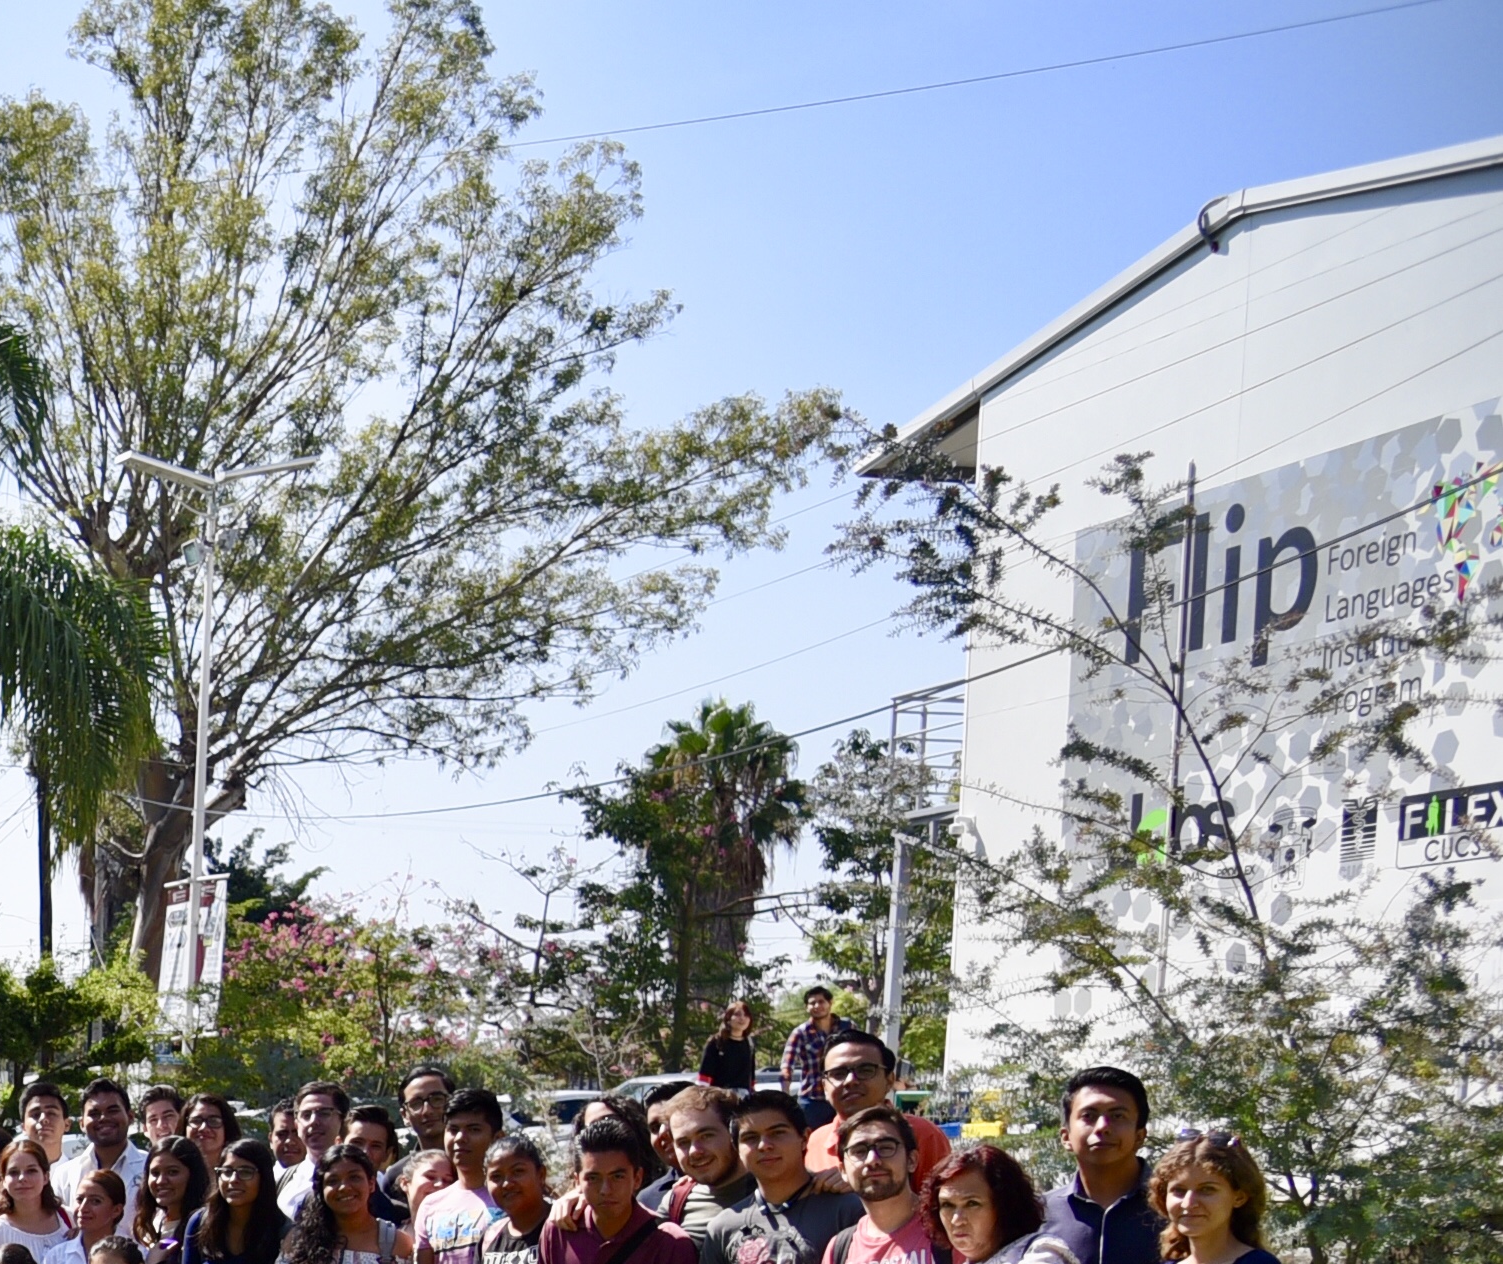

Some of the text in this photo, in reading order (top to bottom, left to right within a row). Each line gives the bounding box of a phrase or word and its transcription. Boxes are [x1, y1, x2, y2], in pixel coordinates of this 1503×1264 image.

[1328, 531, 1417, 576] Foreign
[1124, 503, 1318, 668] Flip
[1325, 570, 1454, 624] Languages
